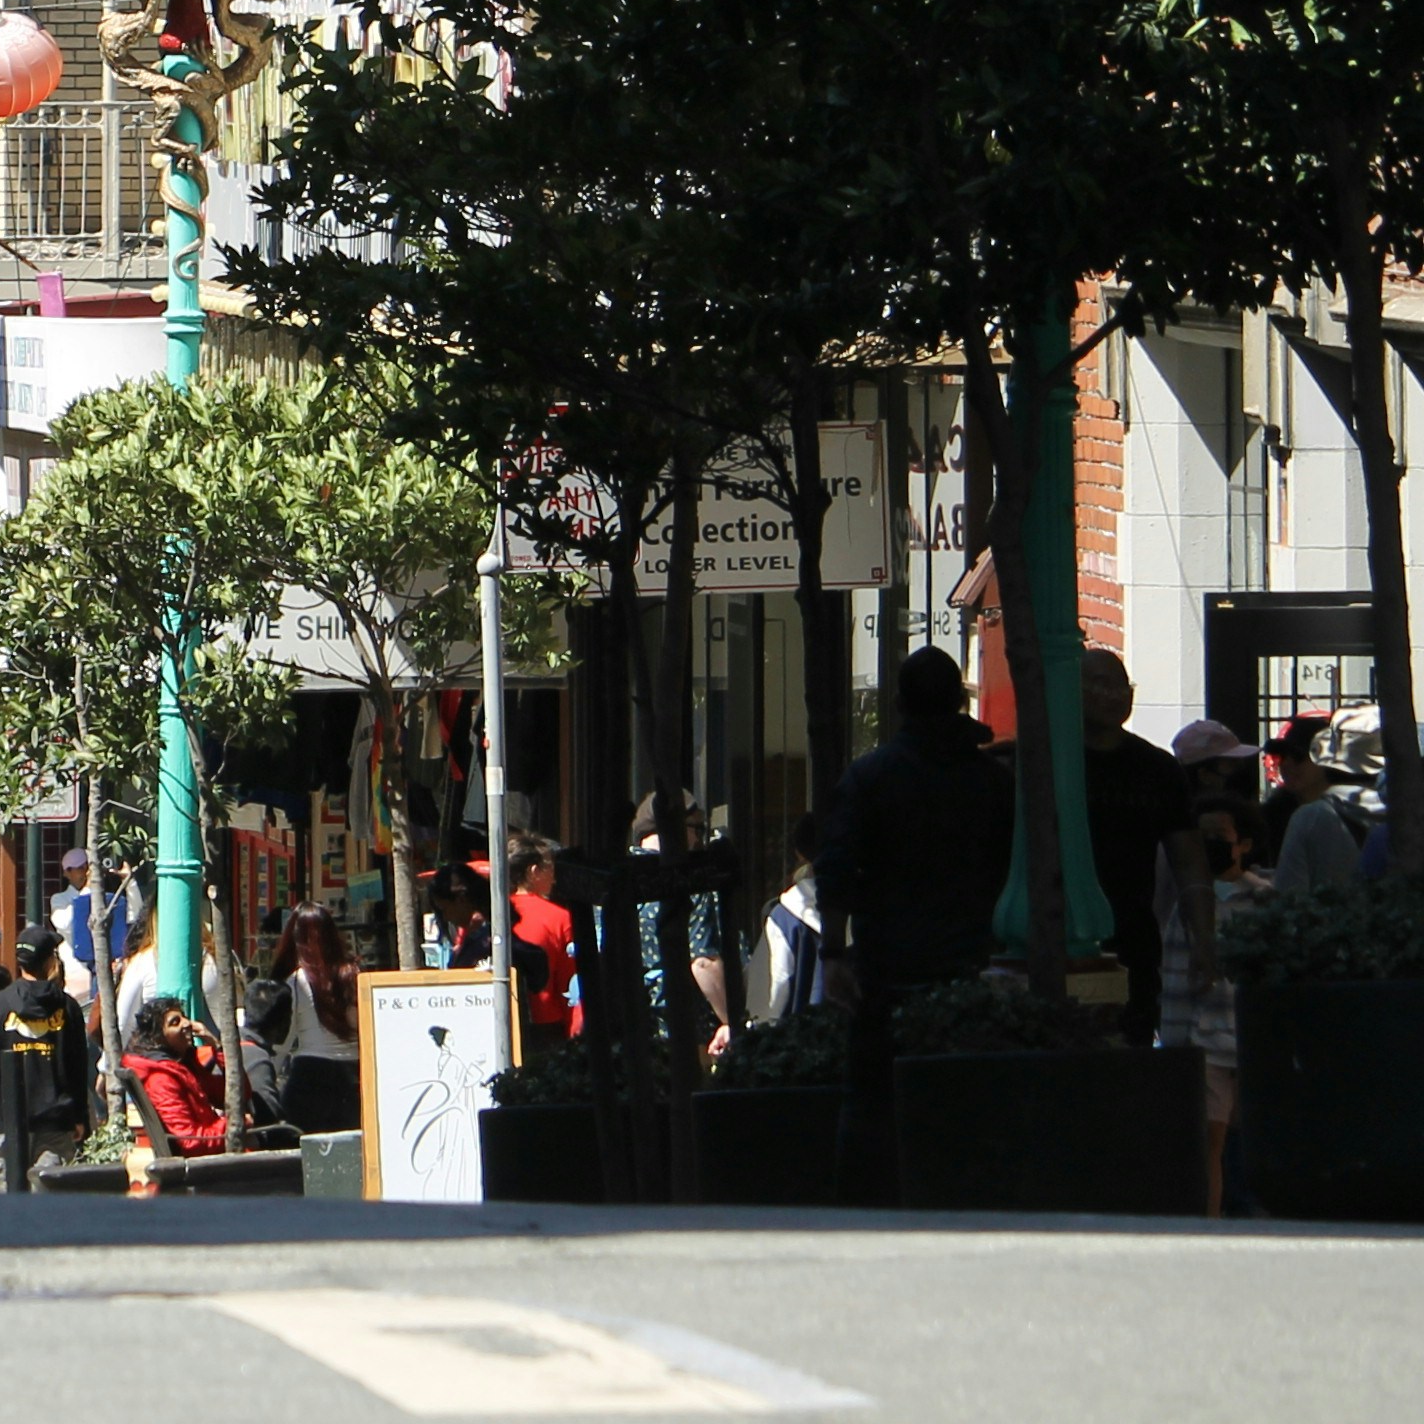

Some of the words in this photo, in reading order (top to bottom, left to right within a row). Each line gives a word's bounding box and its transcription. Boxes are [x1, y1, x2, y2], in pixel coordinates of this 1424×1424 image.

[546, 486, 596, 513] ANY
[712, 474, 862, 502] Furnure
[642, 513, 801, 547] Colection
[644, 558, 717, 574] LOER
[726, 556, 795, 572] LEVEL
[377, 998, 388, 1010] P
[392, 998, 403, 1010] &
[408, 998, 419, 1009] C
[427, 996, 457, 1009] Gift
